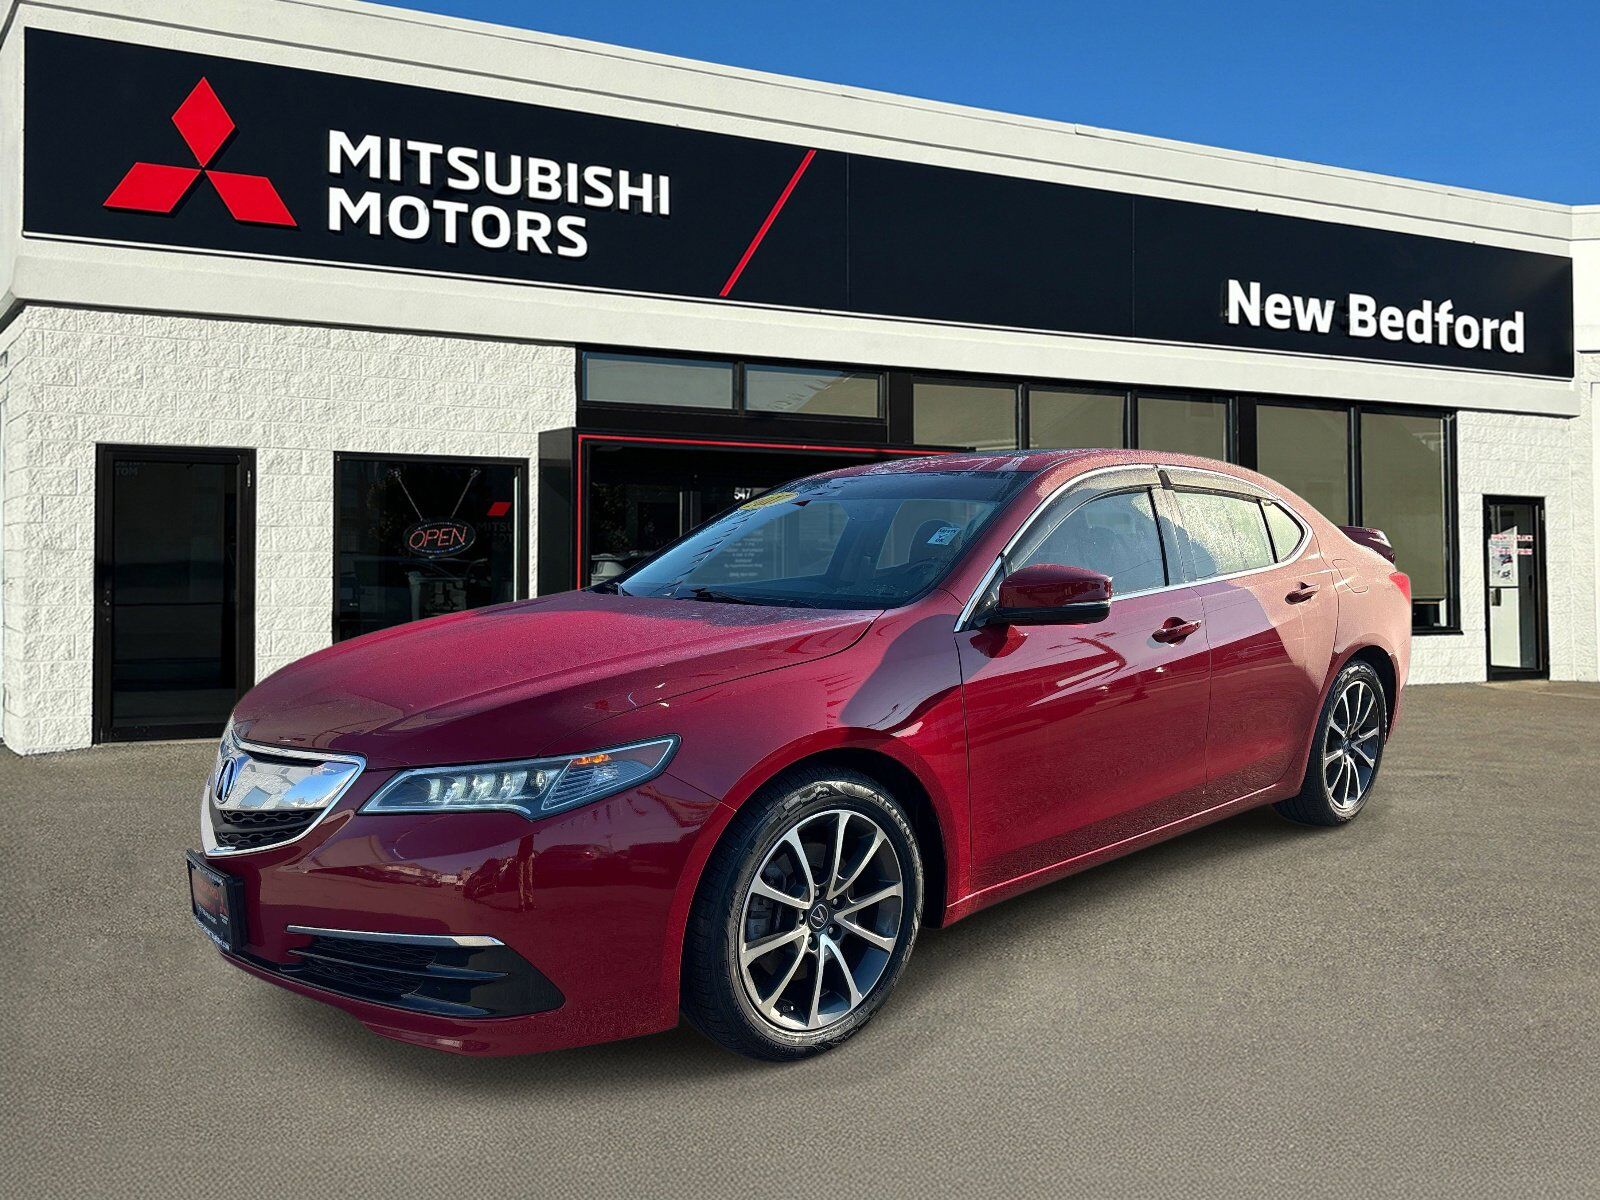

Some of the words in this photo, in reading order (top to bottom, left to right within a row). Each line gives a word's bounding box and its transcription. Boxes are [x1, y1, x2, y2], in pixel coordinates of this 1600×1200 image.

[330, 129, 670, 215] MITSUBISHI
[329, 186, 588, 258] MOTORS
[1228, 279, 1335, 334] New
[1349, 293, 1525, 354] Bedford
[733, 487, 752, 500] 547
[409, 527, 467, 548] OPEN
